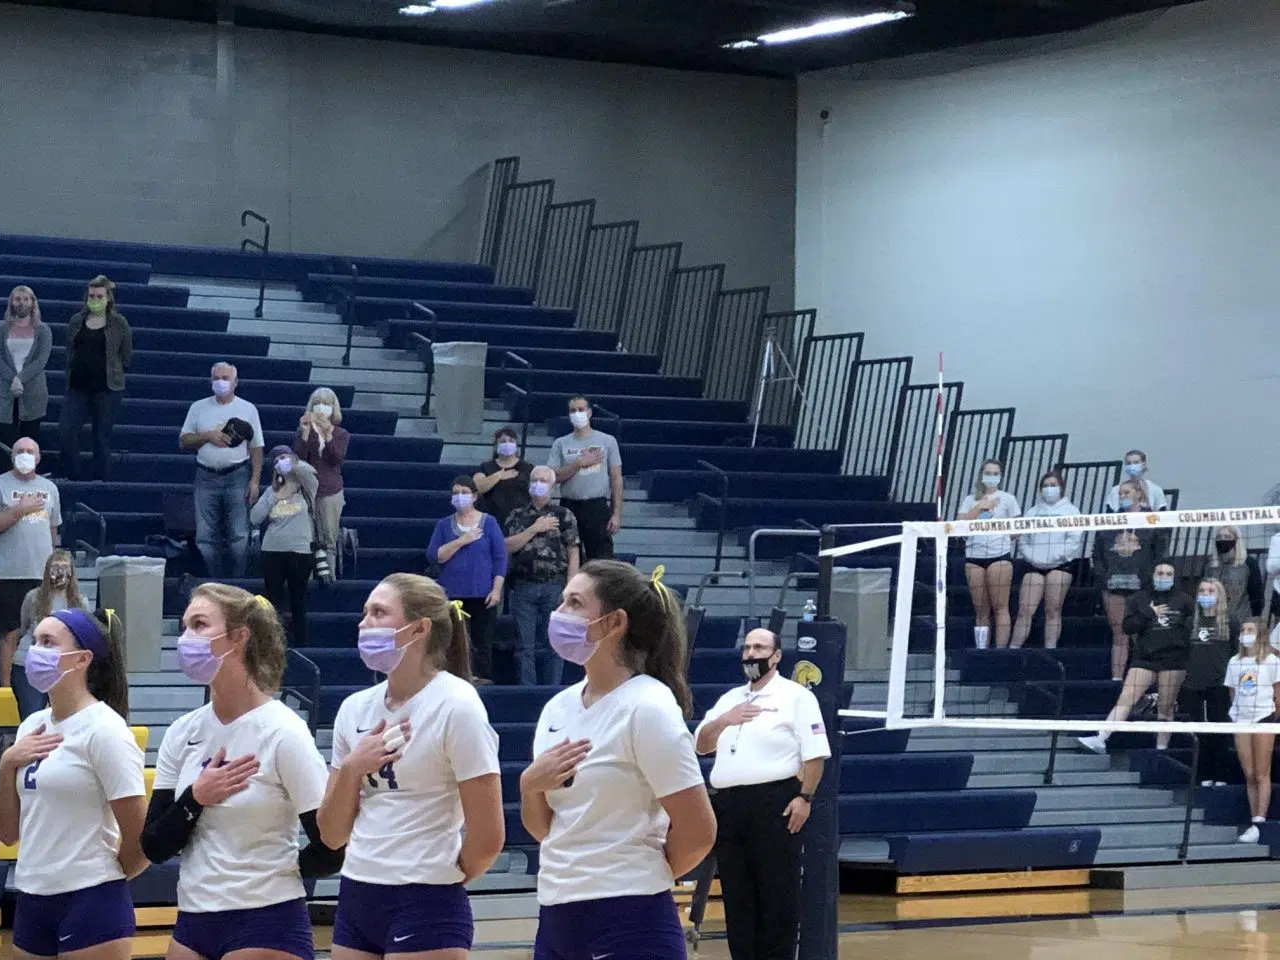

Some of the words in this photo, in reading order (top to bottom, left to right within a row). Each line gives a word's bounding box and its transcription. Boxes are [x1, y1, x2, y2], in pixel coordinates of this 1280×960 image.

[970, 521, 1011, 532] COLUMBIA
[1014, 519, 1054, 530] CENTRAL
[1057, 516, 1091, 527] GOLDEN
[1094, 515, 1128, 526] EAGLES
[1178, 511, 1226, 523] COLUMBIA
[1229, 509, 1274, 521] CENTRAL
[24, 758, 44, 790] 2
